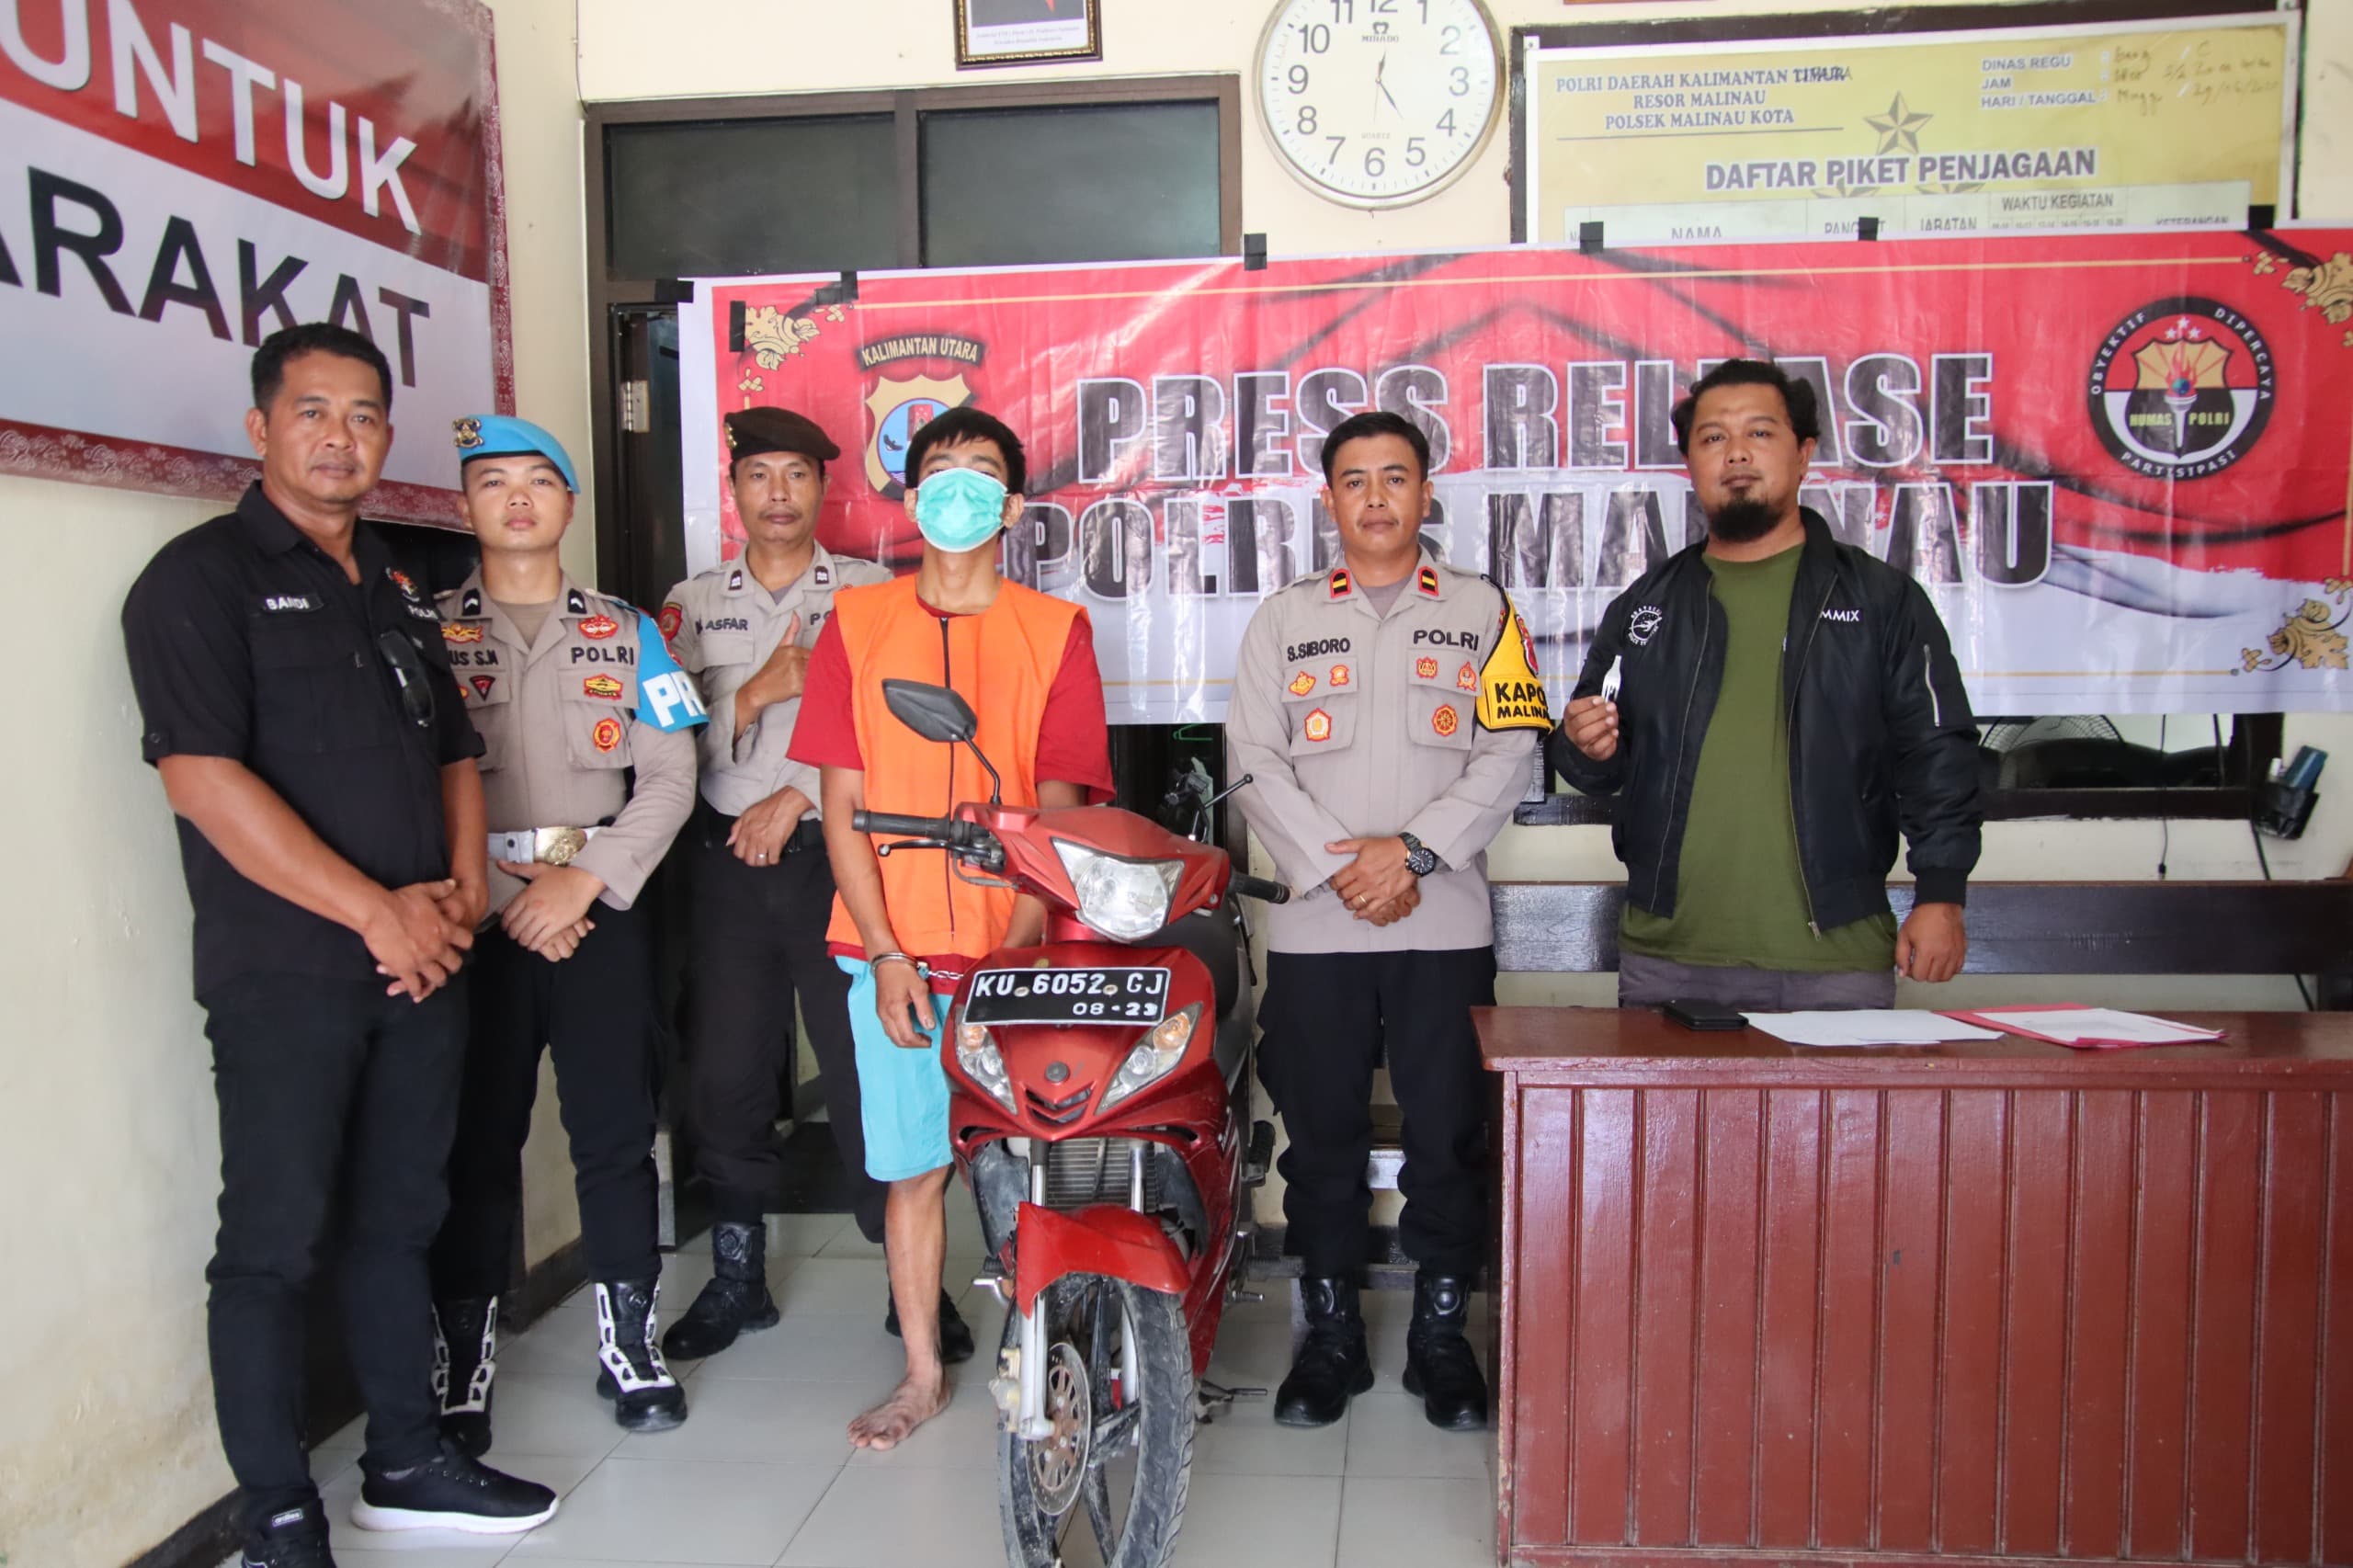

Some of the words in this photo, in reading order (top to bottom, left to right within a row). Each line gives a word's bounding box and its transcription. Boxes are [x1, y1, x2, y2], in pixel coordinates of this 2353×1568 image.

[1330, 0, 1354, 24] 11
[1298, 24, 1330, 54] 10
[1440, 26, 1462, 55] 2
[1982, 57, 2026, 71] DINAS
[2029, 55, 2071, 69] REGU
[1288, 64, 1309, 95] 9
[1449, 66, 1470, 97] 3
[1556, 76, 1602, 92] POLRI
[1608, 74, 1675, 90] DAERAH
[1679, 69, 1789, 89] KALIMANTAN
[1982, 78, 2011, 90] JAM
[1633, 93, 1686, 109] RESOR
[1690, 90, 1766, 108] MALINAU
[1982, 95, 2016, 108] HARI
[2029, 92, 2097, 106] TANGGAL
[1297, 106, 1317, 135] 8
[1436, 108, 1457, 137] 4
[1605, 114, 1665, 131] POLSEK
[1671, 110, 1745, 128] MALINAU
[1750, 108, 1794, 125] KOTA
[1325, 136, 1347, 165] 7
[1364, 147, 1385, 177] 6
[1405, 137, 1427, 167] 5
[1705, 160, 1816, 191] DAFTAR
[1826, 157, 1910, 186] PIKET
[1918, 150, 2096, 182] PENJAGAAN
[2002, 194, 2048, 212] WAKTU
[2052, 192, 2114, 210] KEGIATAN
[0, 165, 431, 388] RAKAT
[861, 336, 938, 367] KALIMANTAN
[939, 337, 979, 363] UTARA
[2091, 312, 2145, 395] OBYEKTIF
[2214, 307, 2271, 400] DIPERCAYA
[1483, 353, 1995, 472] RELASE
[2130, 413, 2173, 427] HUMAS
[2188, 412, 2231, 426] POLRI
[1483, 480, 2055, 595] MANAU
[705, 618, 748, 631] ASFAR
[571, 645, 634, 665] POLRI
[1287, 637, 1351, 663] S.SIBORO
[1413, 629, 1480, 652] POLRI
[975, 974, 1015, 997] KU
[1032, 972, 1106, 995] 6052
